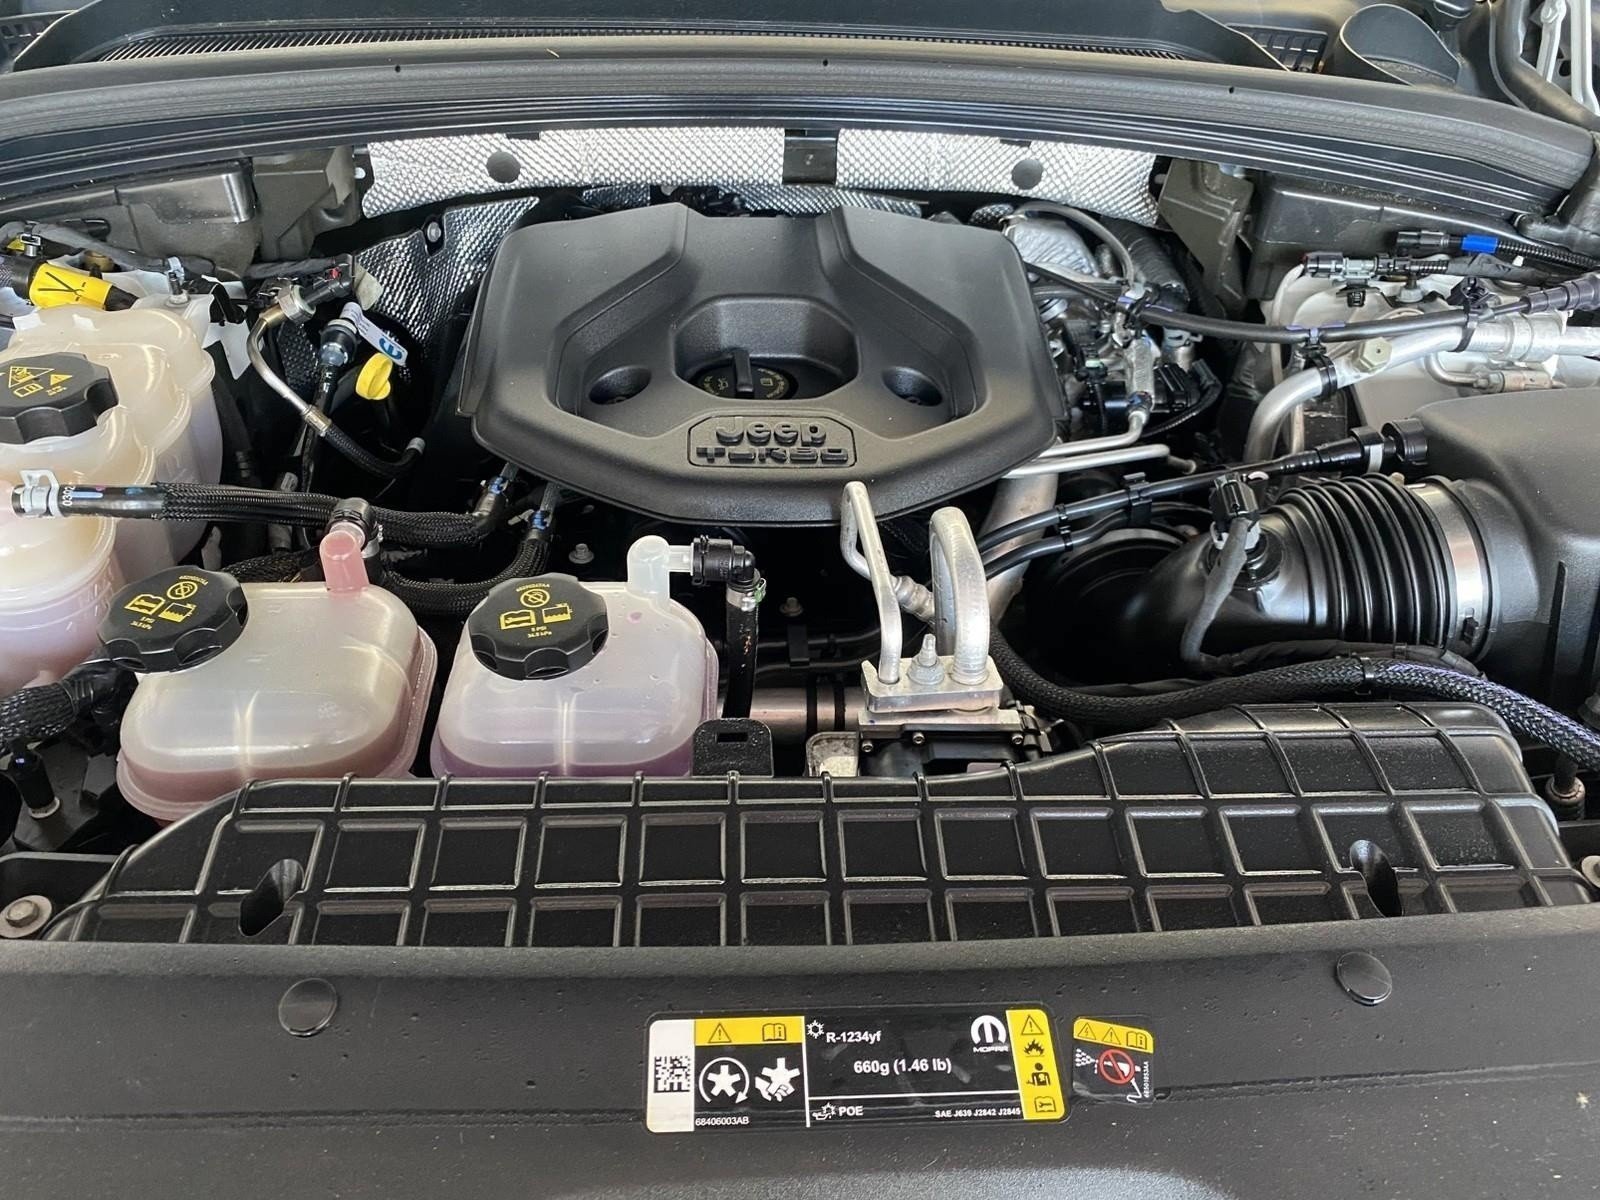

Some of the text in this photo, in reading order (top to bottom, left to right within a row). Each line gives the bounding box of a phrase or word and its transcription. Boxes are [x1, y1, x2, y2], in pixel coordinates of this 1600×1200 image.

[716, 416, 827, 446] Jeep
[826, 1031, 882, 1044] R-1234yf
[853, 1058, 952, 1075] 660g (1.46 lb)
[838, 1106, 864, 1116] POE
[934, 1107, 1022, 1118] SAE J639 J2842 J2845
[695, 1116, 750, 1126] 68406003AB
